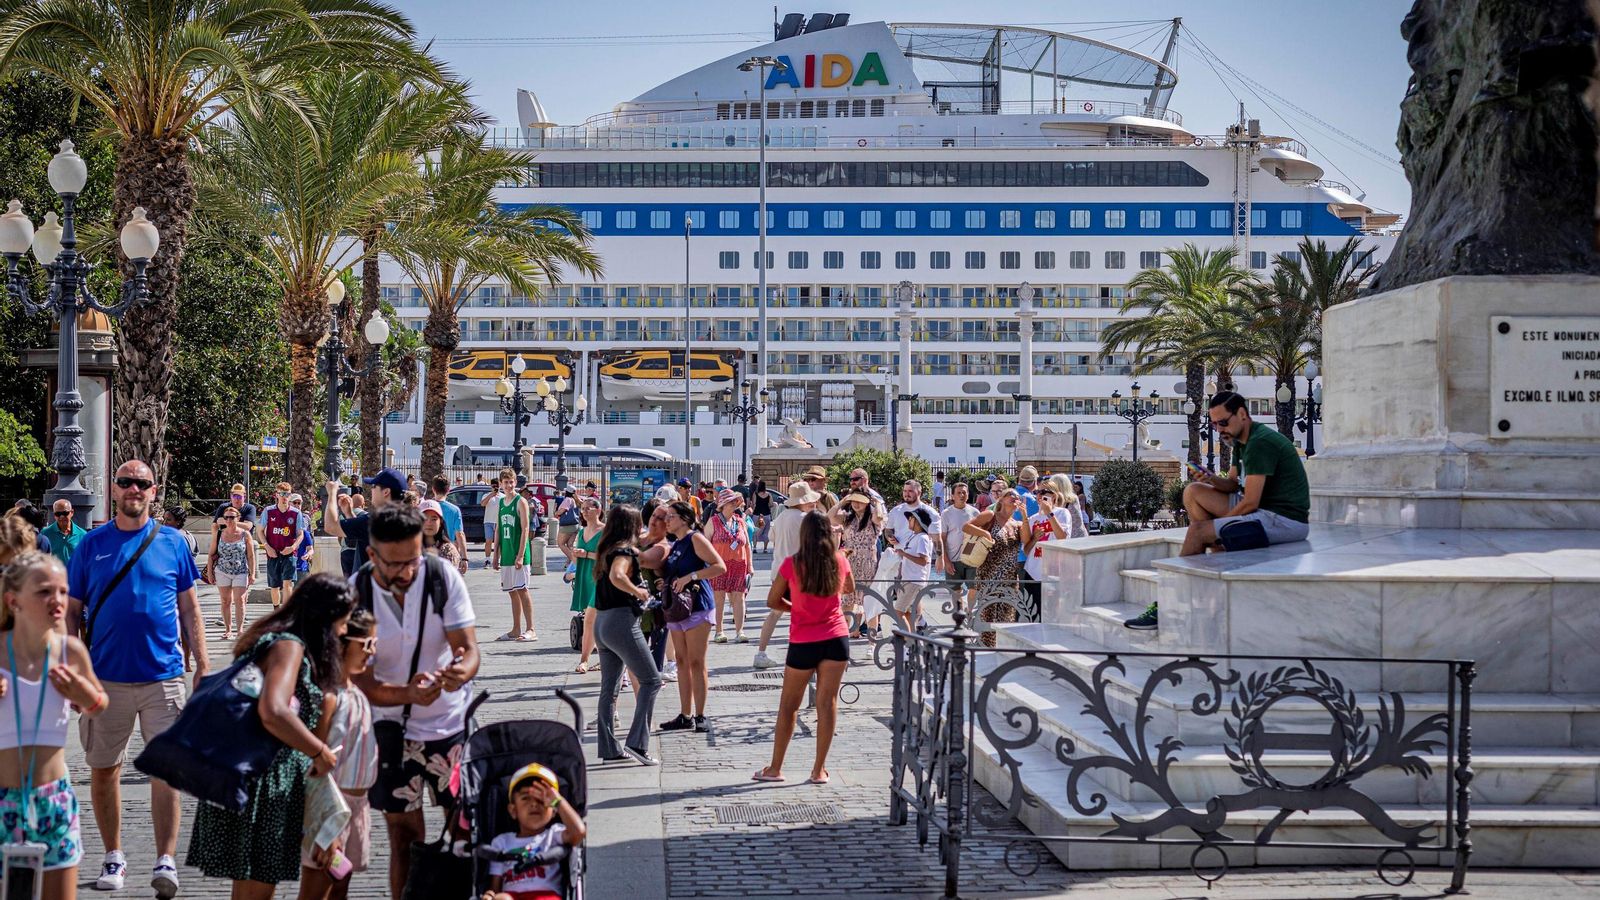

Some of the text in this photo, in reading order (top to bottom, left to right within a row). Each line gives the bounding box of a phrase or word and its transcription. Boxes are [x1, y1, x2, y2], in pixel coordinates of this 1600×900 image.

[764, 52, 889, 90] AIDA
[1522, 331, 1600, 341] ESTE MONUMEN
[1574, 370, 1580, 380] A
[1504, 390, 1543, 402] EXCMO.
[1545, 390, 1552, 402] E
[1557, 390, 1585, 402] ILMO.
[503, 527, 510, 538] 11
